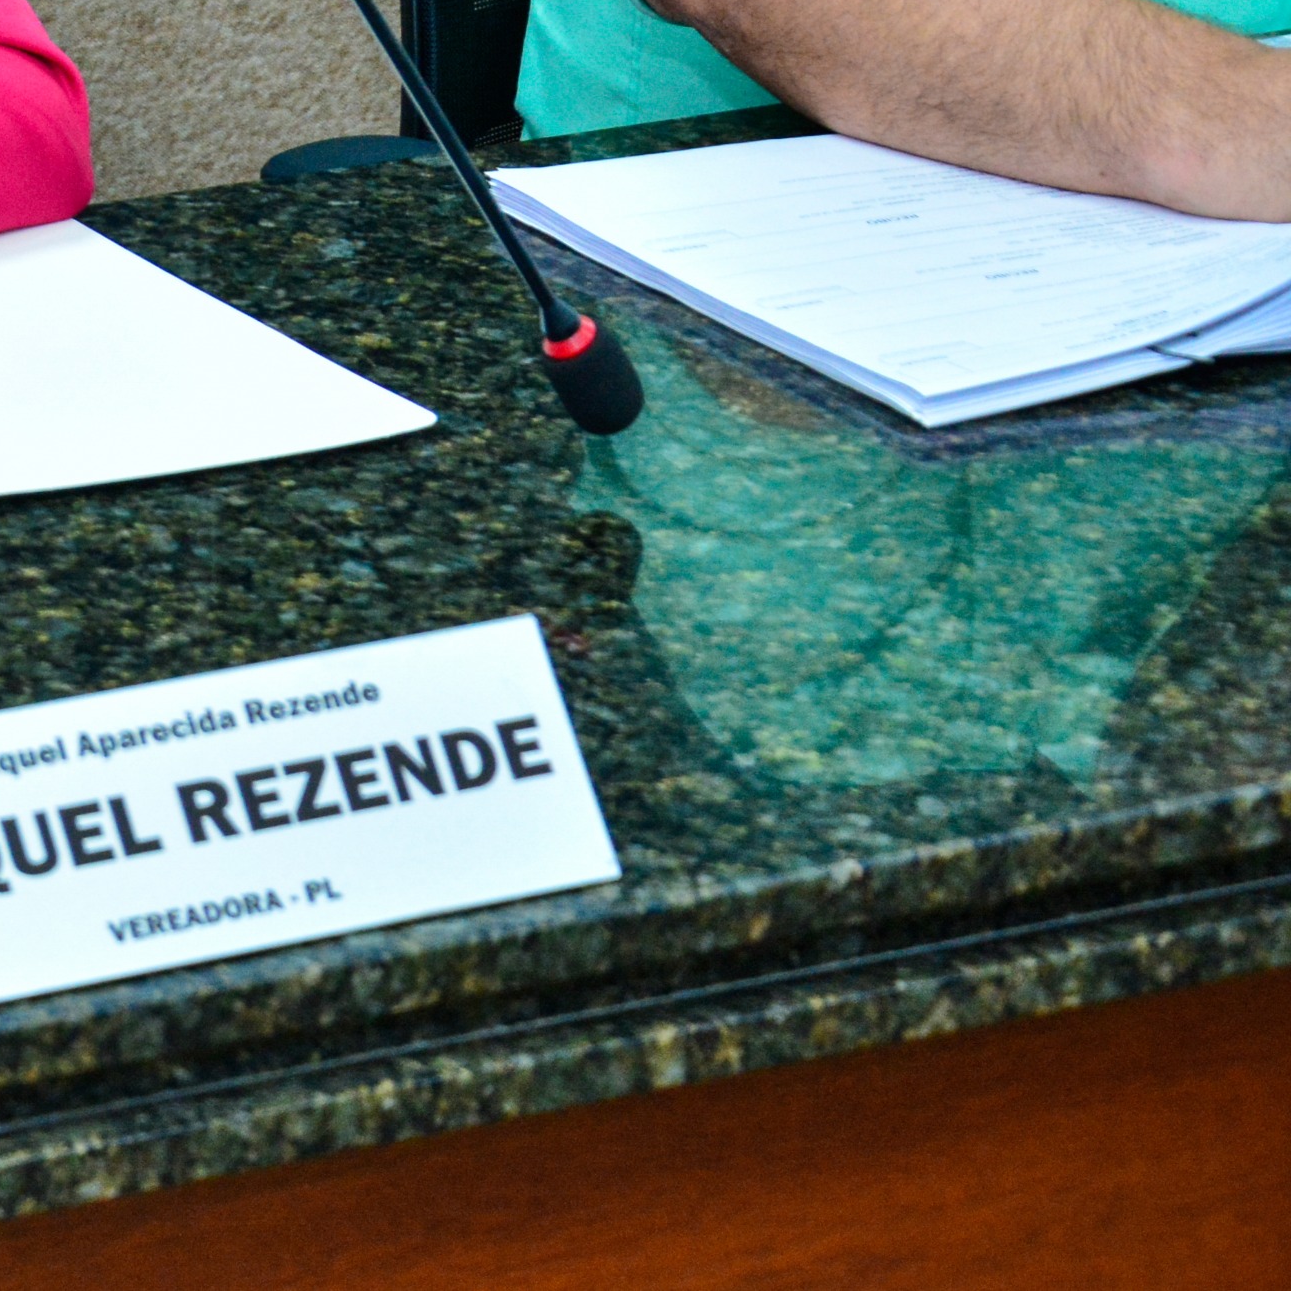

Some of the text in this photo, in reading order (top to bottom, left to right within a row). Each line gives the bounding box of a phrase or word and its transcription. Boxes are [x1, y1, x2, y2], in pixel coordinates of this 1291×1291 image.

[77, 707, 237, 759] Aparecida
[242, 680, 381, 726] Rezende
[175, 715, 554, 845] REZENDE
[108, 891, 283, 943] VEREADORA
[304, 878, 343, 904] PL
